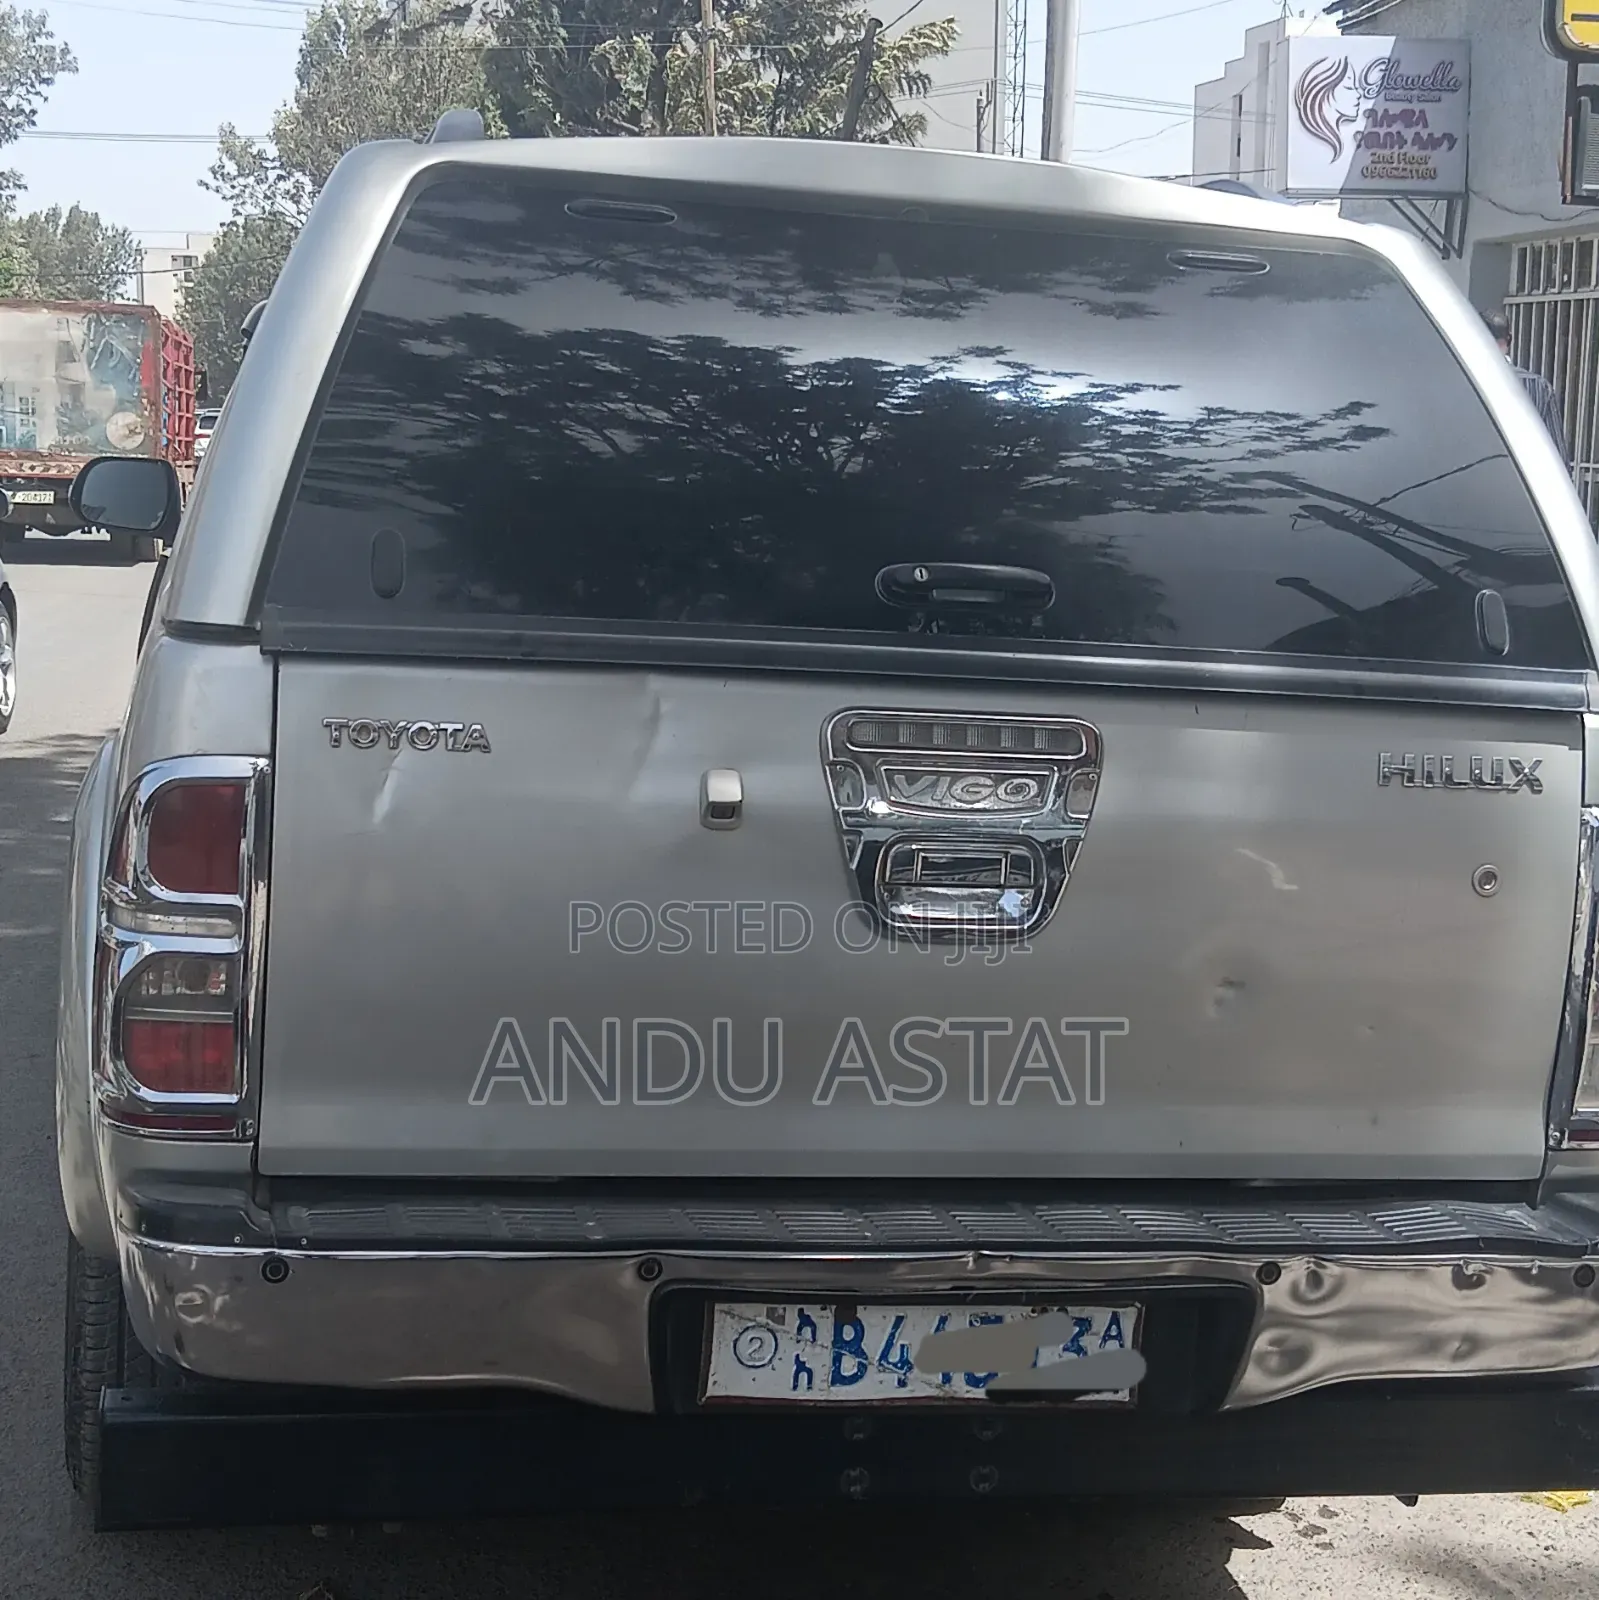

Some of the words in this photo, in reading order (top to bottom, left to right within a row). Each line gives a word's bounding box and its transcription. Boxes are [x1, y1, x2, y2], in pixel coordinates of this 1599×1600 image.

[1359, 57, 1462, 99] Glowella
[1370, 151, 1396, 165] 2nd
[1397, 151, 1431, 165] Floor
[322, 717, 491, 753] TOYOTA
[893, 774, 1039, 803] VIGO
[1378, 752, 1544, 794] HILUX
